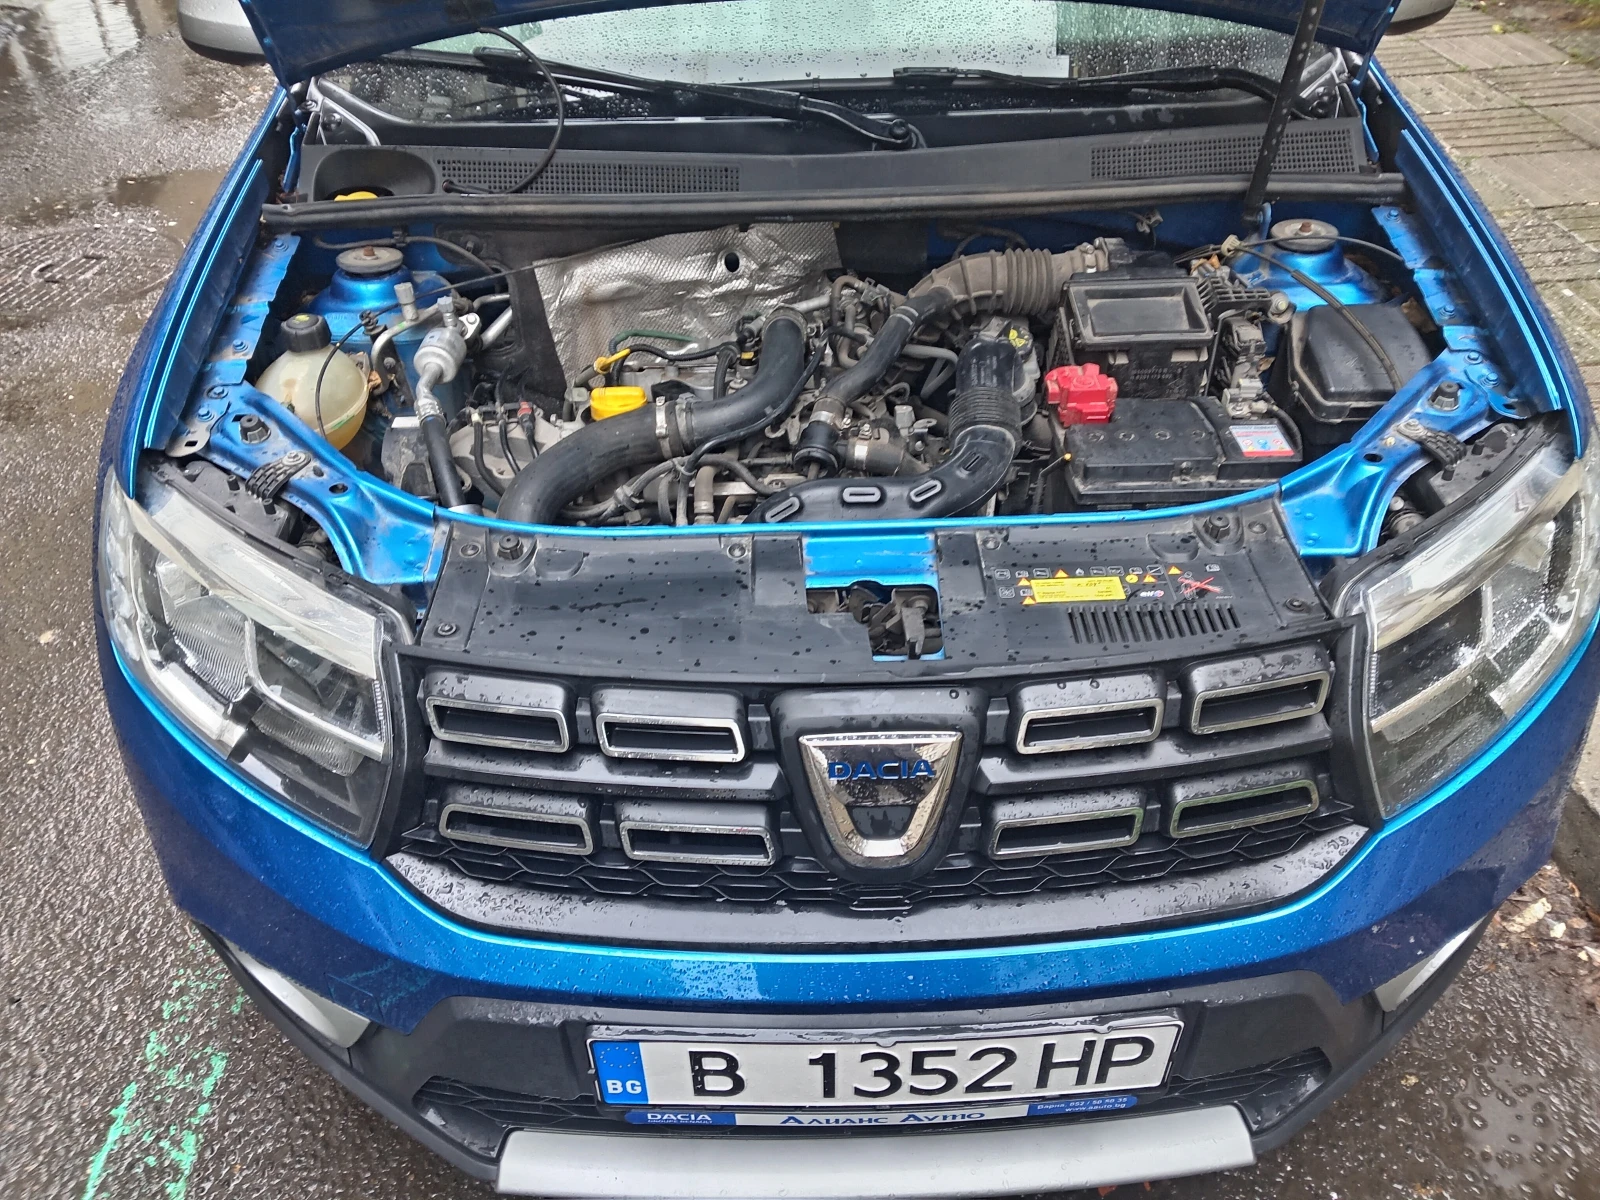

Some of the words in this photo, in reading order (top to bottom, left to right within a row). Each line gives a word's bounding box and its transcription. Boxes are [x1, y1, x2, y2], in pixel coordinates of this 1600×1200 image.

[828, 759, 936, 780] DACIA
[689, 1050, 746, 1097] B
[808, 1048, 1018, 1099] 1352
[1036, 1035, 1154, 1090] HP
[606, 1079, 642, 1094] BG
[647, 1113, 711, 1121] DACIA
